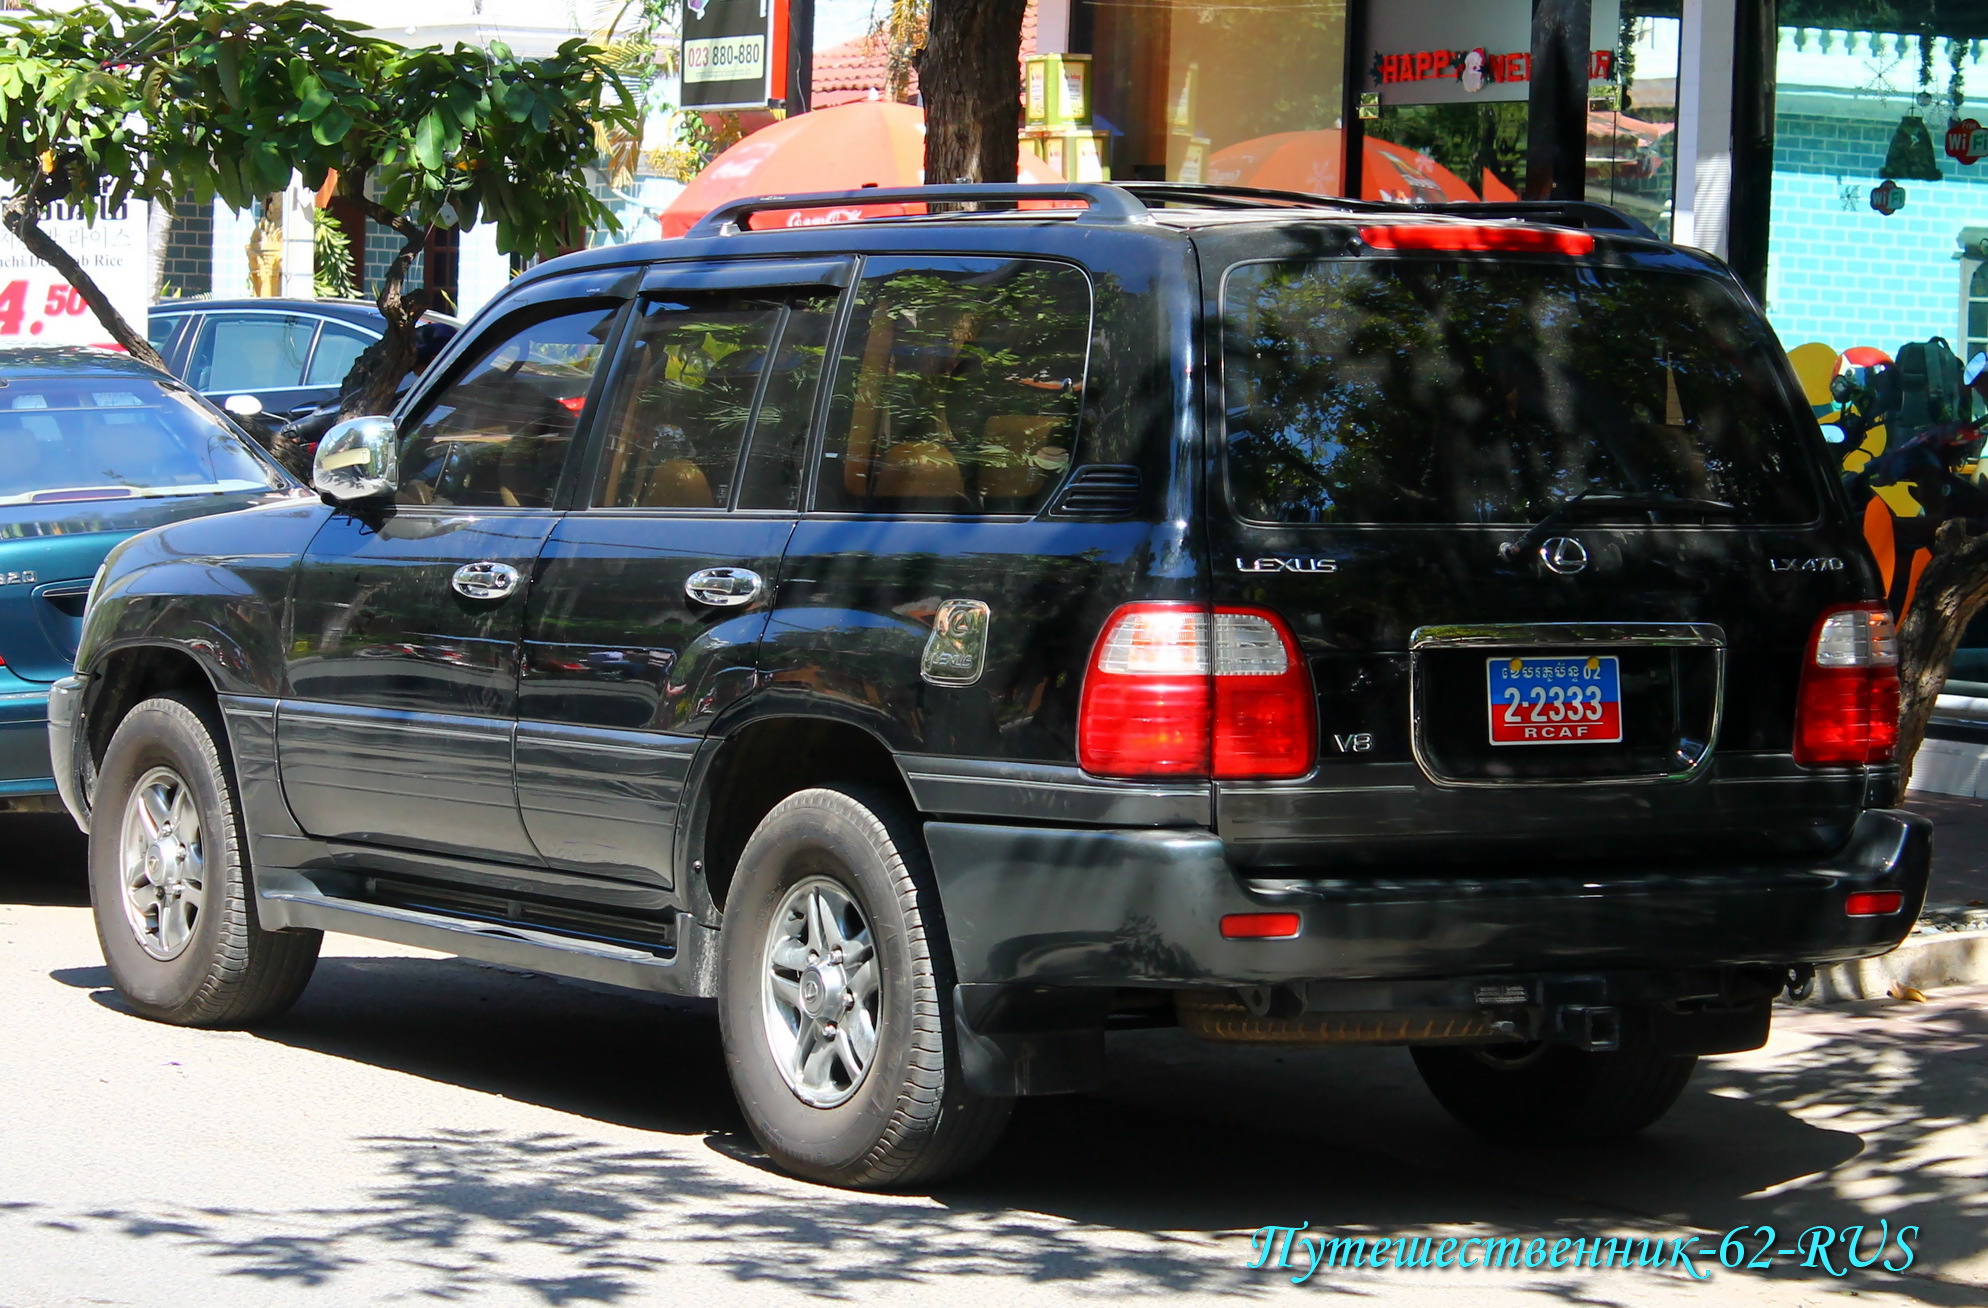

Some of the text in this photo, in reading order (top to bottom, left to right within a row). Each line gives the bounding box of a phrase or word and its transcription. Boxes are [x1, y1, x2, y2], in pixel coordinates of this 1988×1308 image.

[688, 43, 760, 67] 023 880-880
[1488, 52, 1530, 83] NE
[69, 227, 132, 249] 라이스
[95, 255, 123, 268] Rice
[1235, 557, 1338, 573] LEXUS
[931, 651, 973, 669] LEXUS
[1524, 726, 1588, 738] RCAF
[1333, 732, 1373, 752] V8
